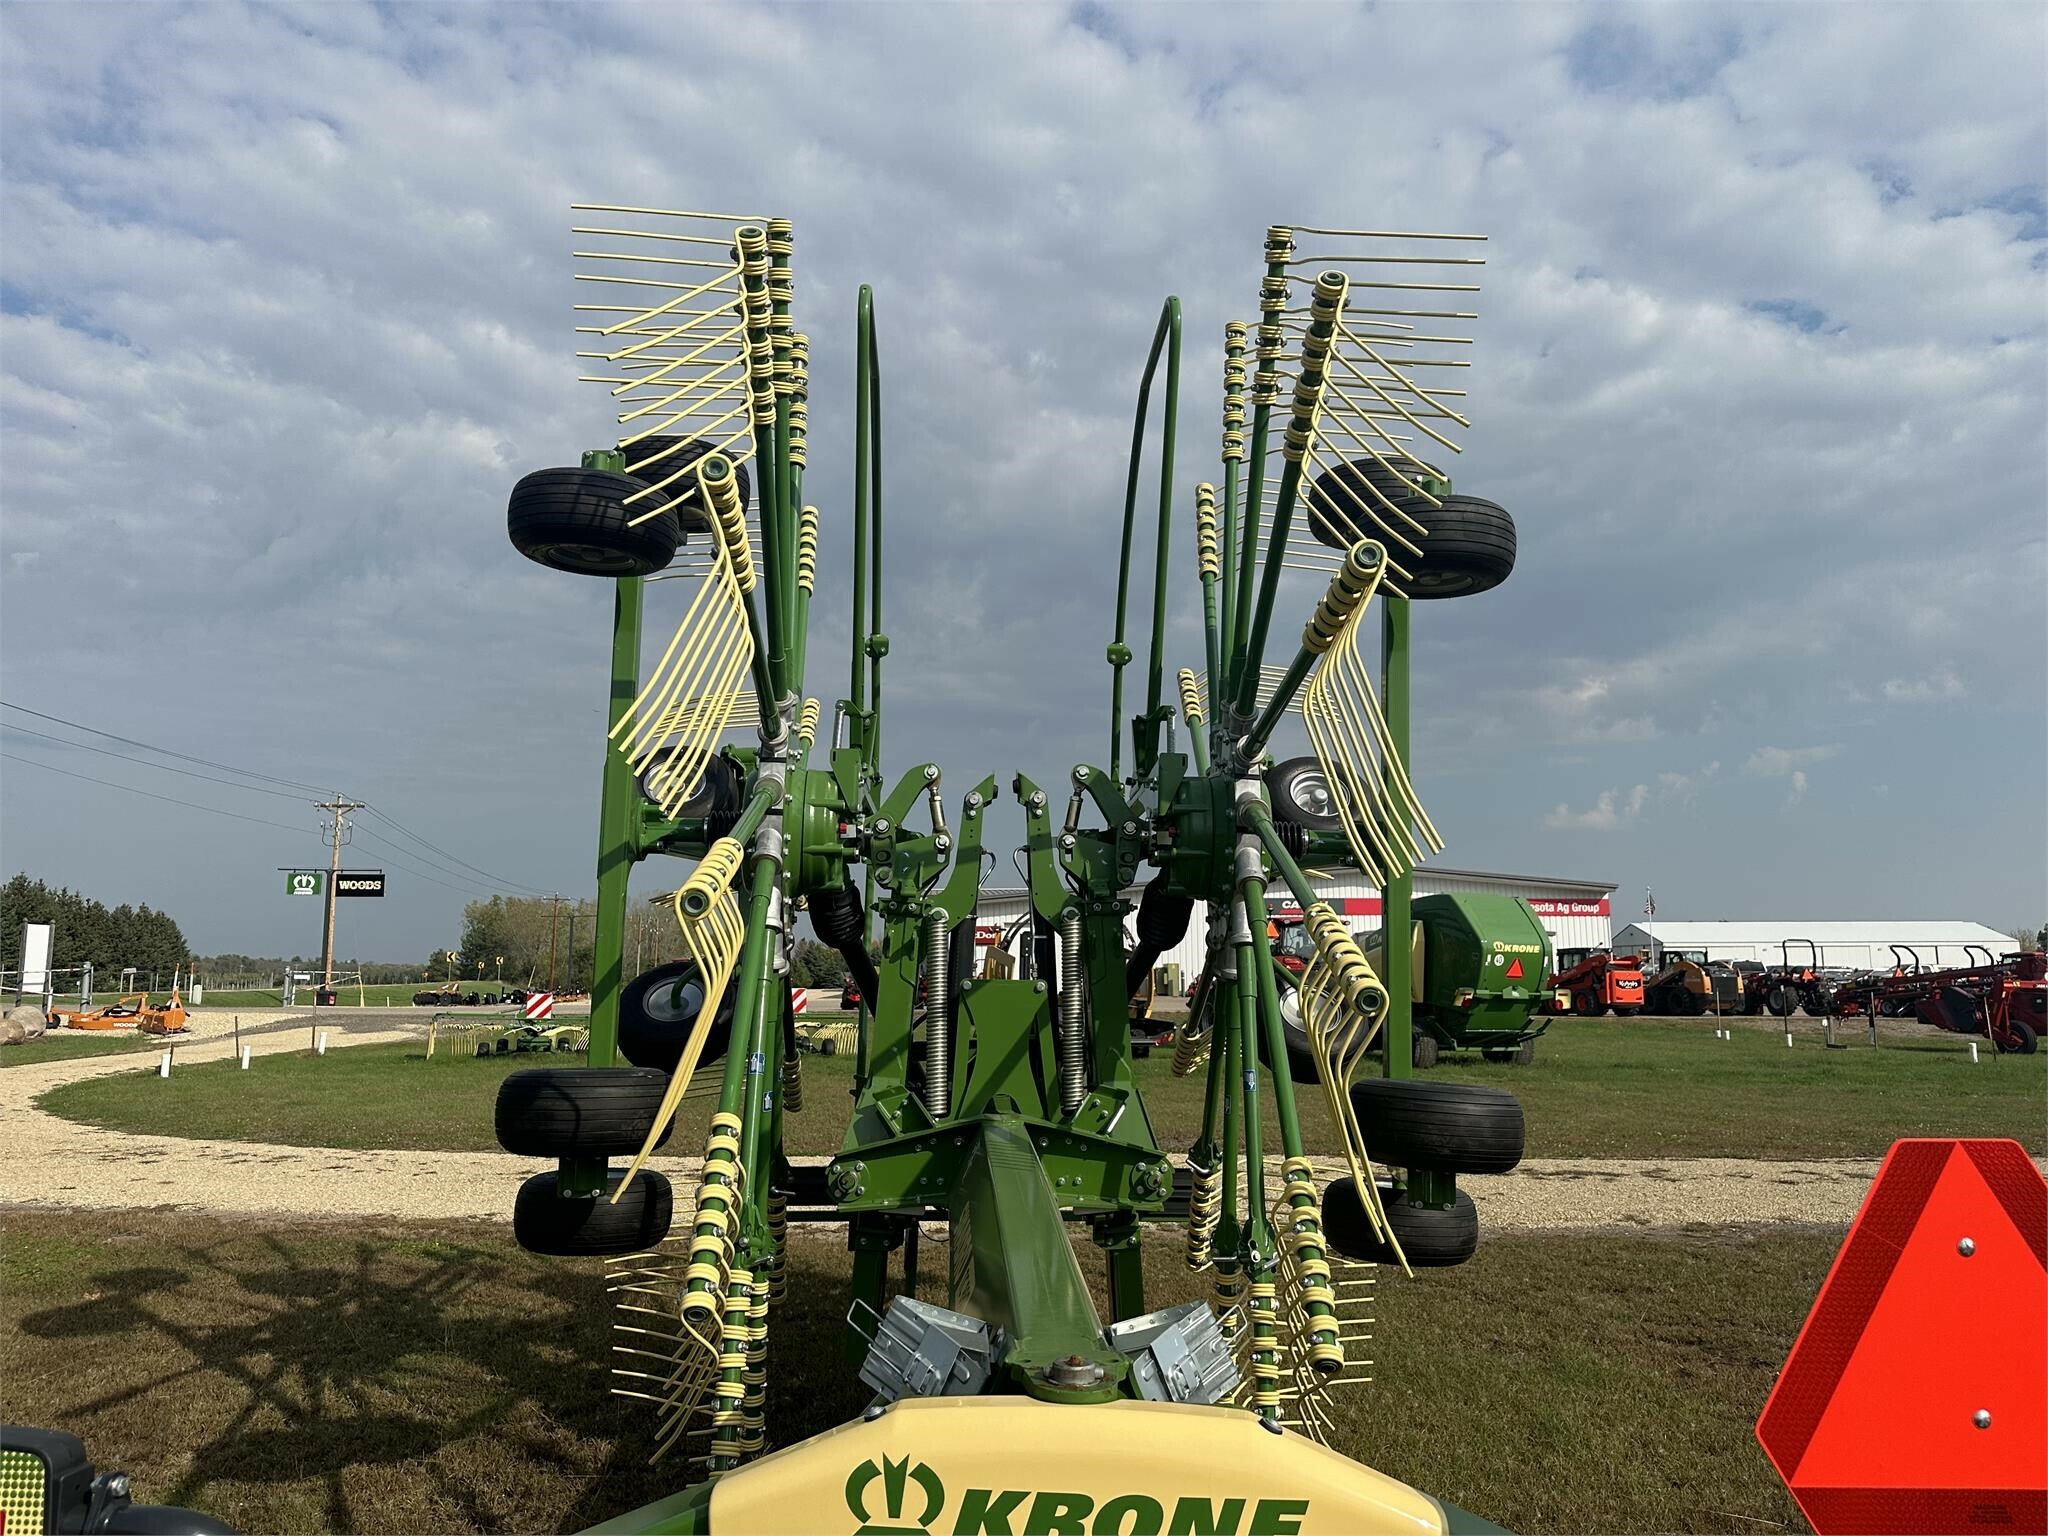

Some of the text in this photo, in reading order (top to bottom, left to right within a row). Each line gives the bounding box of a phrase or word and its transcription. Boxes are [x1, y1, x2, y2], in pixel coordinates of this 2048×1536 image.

[338, 880, 382, 890] WOODS
[1281, 900, 1301, 909] CA
[1557, 903, 1570, 914] Ag
[1572, 902, 1600, 914] Group
[1503, 944, 1540, 953] KRONE
[952, 1488, 1310, 1536] KRONE
